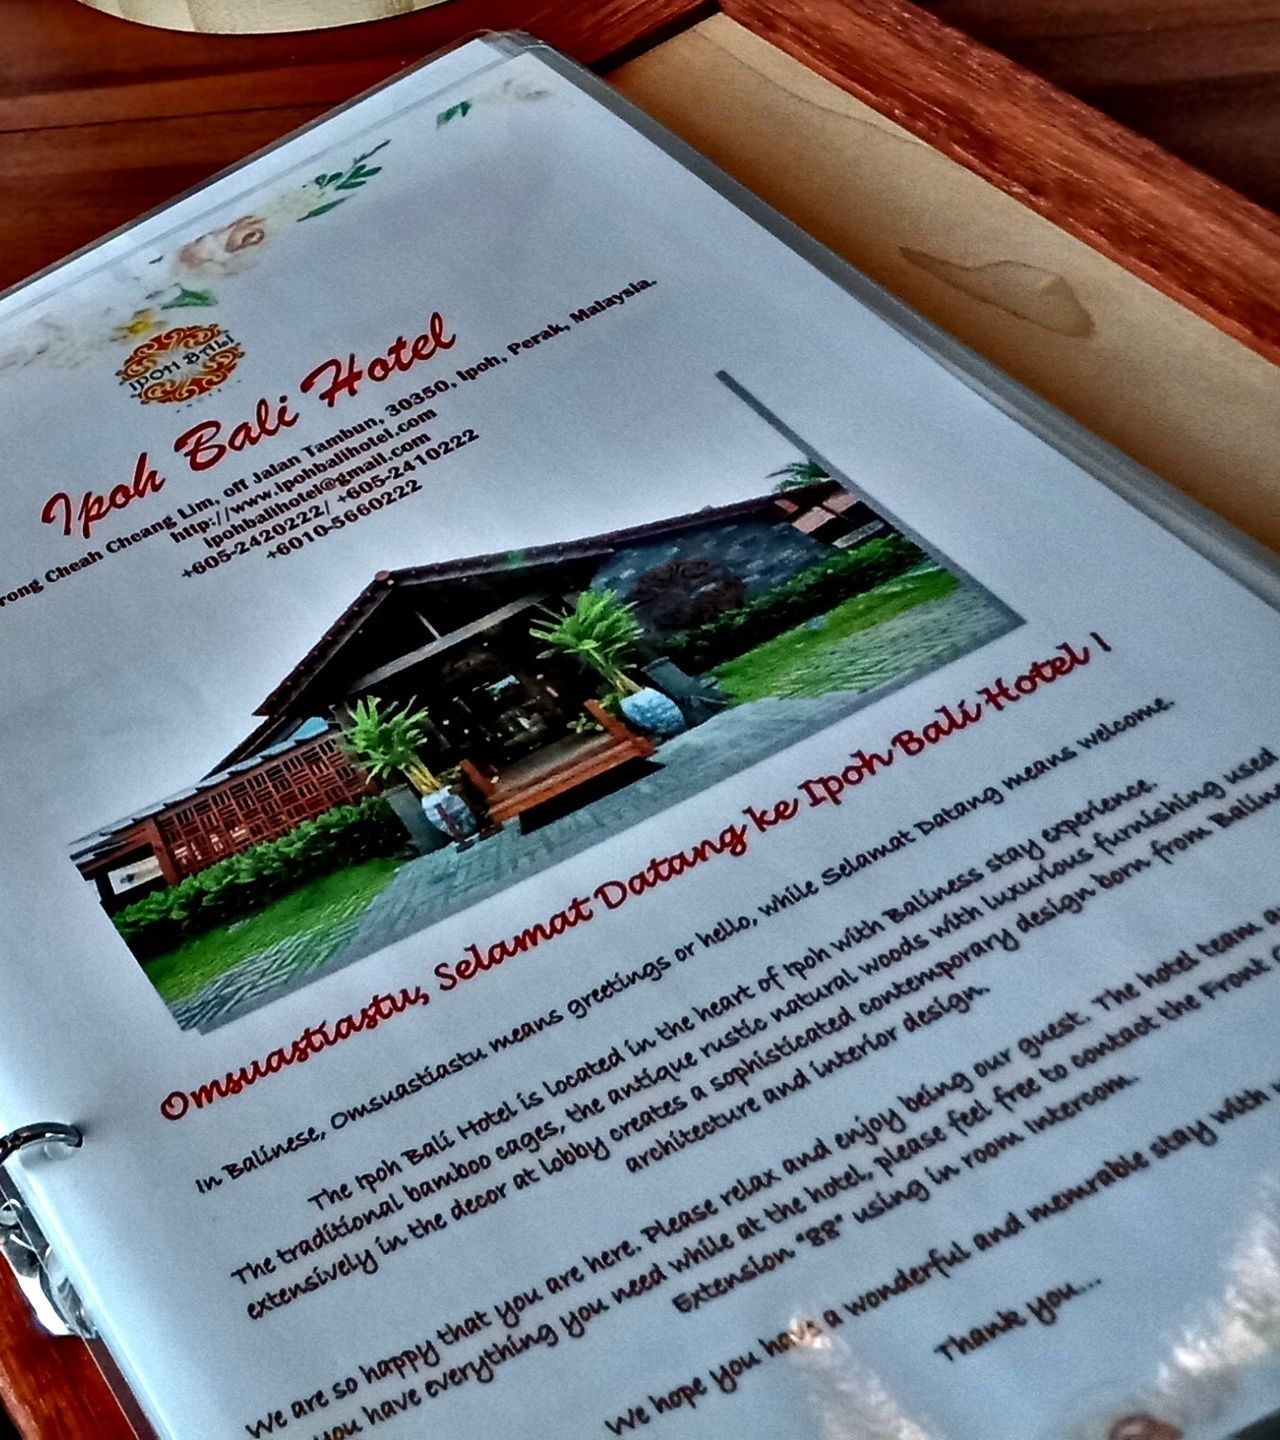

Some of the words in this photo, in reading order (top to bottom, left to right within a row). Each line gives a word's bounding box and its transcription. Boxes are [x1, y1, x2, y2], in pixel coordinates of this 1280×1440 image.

[40, 451, 167, 540] Ipoh
[172, 394, 299, 473] Bali
[299, 311, 458, 408] Hotel
[45, 552, 103, 582] Cheah
[106, 516, 177, 553] Cheang
[177, 498, 220, 519] Lim,
[224, 479, 249, 497] off
[253, 456, 301, 484] Jalan
[301, 418, 384, 457] Tambun,
[385, 381, 457, 416] 30350,
[456, 357, 507, 381] Ipoh,
[507, 325, 570, 355] Perak,
[569, 280, 657, 323] Malaysia.
[129, 361, 181, 392] IPOH
[182, 334, 236, 366] BALI
[170, 409, 437, 543] http://www.ipohbalihotel.com
[182, 500, 330, 577] +605-2420222/
[338, 429, 479, 502] +605-2410222
[203, 434, 431, 548] ipohbalihotel@gmail.com
[267, 480, 422, 558] +6010-5660222
[161, 987, 429, 1120] Omsuastiastu,
[434, 897, 593, 991] Selamat
[593, 824, 747, 909] Datang
[742, 798, 798, 832] ke
[797, 749, 893, 807] Ipoh
[891, 700, 981, 756] Bali
[976, 642, 1090, 711] Hotel
[196, 1176, 222, 1193] In
[221, 1127, 326, 1180] Balinese,
[331, 1048, 488, 1129] Omsuastiastu
[489, 1010, 564, 1052] means
[568, 956, 671, 1019] greetings
[675, 942, 694, 961] or
[695, 916, 757, 947] hello,
[758, 881, 819, 916] while
[821, 831, 916, 886] Selamat
[913, 787, 1004, 835] Datang
[1002, 747, 1077, 790] means
[1077, 698, 1174, 749] welcome.
[231, 1257, 276, 1284] The
[276, 1193, 404, 1264] traditional
[402, 1155, 491, 1202] bamboo
[496, 1121, 565, 1160] cages,
[565, 1098, 605, 1123] the
[608, 1052, 698, 1104] antique
[700, 1018, 767, 1058] rustic
[770, 968, 859, 1022] natural
[858, 934, 929, 975] woods
[929, 907, 984, 938] with
[980, 848, 1094, 910] luxurious
[1093, 782, 1226, 855] furnishing
[1222, 746, 1280, 785] used
[308, 1184, 353, 1210] The
[355, 1160, 402, 1194] Ipoh
[401, 1130, 455, 1166] Bali
[457, 1101, 518, 1139] Hotel
[517, 1092, 544, 1110] is
[543, 1047, 625, 1097] located
[625, 1039, 656, 1056] in
[655, 1016, 695, 1041] the
[692, 985, 756, 1022] heart
[758, 966, 785, 992] of
[783, 948, 831, 980] Ipoh
[830, 920, 885, 952] with
[882, 868, 984, 923] Baliness
[986, 839, 1045, 872] stay
[1042, 780, 1157, 843] experience.
[244, 1410, 288, 1440] We
[291, 1390, 329, 1419] are
[332, 1377, 358, 1399] so
[359, 1340, 440, 1384] happy
[437, 1311, 492, 1345] that
[494, 1288, 544, 1328] you
[546, 1266, 584, 1294] are
[582, 1241, 641, 1273] here.
[640, 1199, 719, 1243] Please
[720, 1169, 781, 1206] relax
[783, 1138, 832, 1175] and
[835, 1108, 907, 1149] enjoy
[897, 1072, 974, 1113] being
[974, 1049, 1011, 1078] our
[1018, 1012, 1091, 1059] guest.
[1091, 983, 1140, 1011] The
[1136, 950, 1200, 988] hotel
[1196, 923, 1264, 957] team
[248, 1249, 378, 1319] extensively
[375, 1236, 408, 1254] in
[407, 1213, 447, 1239] the
[451, 1183, 506, 1220] decor
[513, 1168, 540, 1190] at
[538, 1137, 610, 1175] lobby
[610, 1096, 688, 1142] creates
[690, 1086, 708, 1101] a
[710, 1006, 856, 1092] sophisticated
[859, 928, 1019, 1015] contemporary
[1016, 888, 1096, 933] design
[1090, 859, 1151, 889] born
[1151, 827, 1212, 864] from
[362, 1389, 421, 1425] have
[425, 1324, 558, 1398] everything
[559, 1299, 610, 1338] you
[611, 1263, 667, 1304] need
[668, 1233, 734, 1273] while
[737, 1217, 765, 1240] at
[763, 1197, 807, 1224] the
[803, 1164, 873, 1204] hotel,
[873, 1126, 947, 1177] please
[947, 1099, 992, 1136] feel
[993, 1078, 1041, 1112] free
[1039, 1064, 1068, 1082] to
[1071, 1016, 1160, 1068] contact
[1157, 995, 1201, 1020] the
[1198, 958, 1272, 1000] Front
